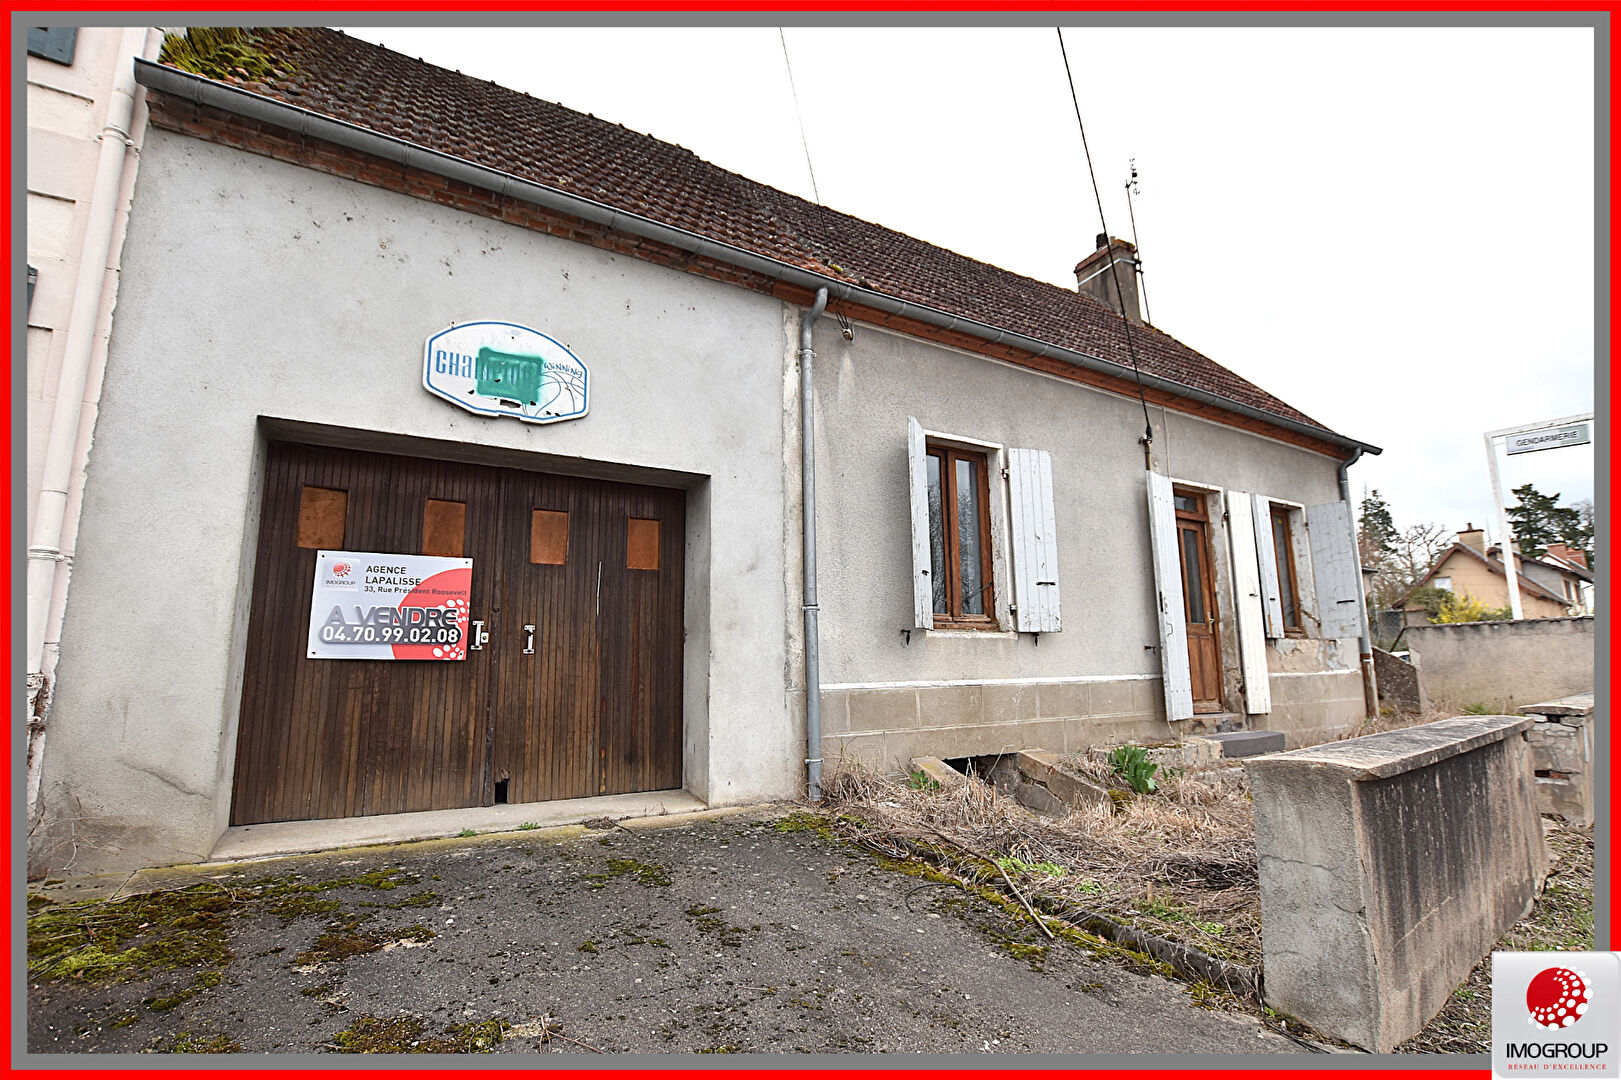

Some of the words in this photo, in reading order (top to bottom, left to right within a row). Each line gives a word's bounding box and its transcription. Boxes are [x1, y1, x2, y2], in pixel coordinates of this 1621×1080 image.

[1516, 431, 1578, 446] GENDARMERIE
[366, 565, 407, 575] AGENCE
[365, 576, 421, 586] LAPALISSE
[364, 585, 376, 594] 33,
[377, 586, 392, 594] Rue
[325, 605, 346, 626] A
[355, 605, 458, 628] VENDRE
[323, 626, 459, 643] 04.70.99.02.08
